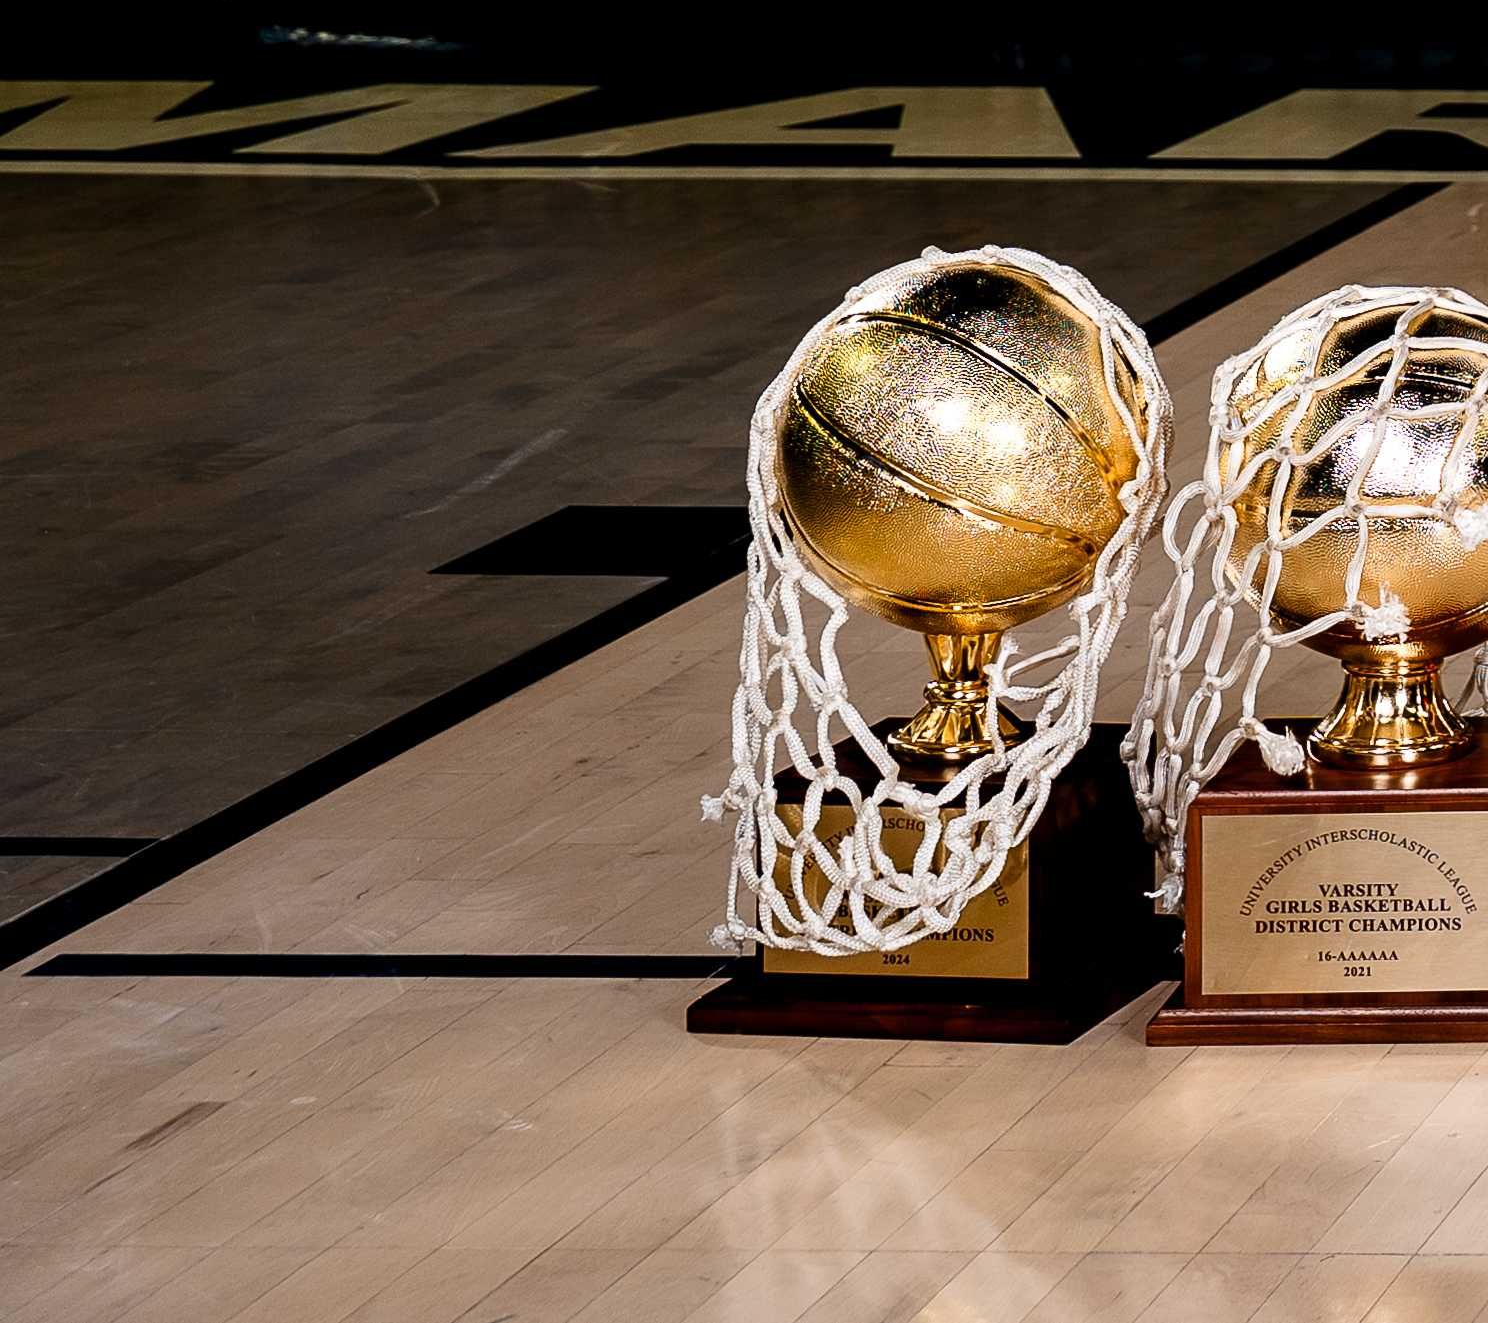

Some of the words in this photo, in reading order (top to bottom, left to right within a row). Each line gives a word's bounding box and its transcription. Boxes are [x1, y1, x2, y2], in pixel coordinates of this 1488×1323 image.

[1240, 844, 1304, 917] UNIVERSITY
[1306, 828, 1439, 865] INTERSCHOLASTIC
[1437, 860, 1478, 914] LEAGUE
[1318, 883, 1400, 897] VARSITY
[1266, 900, 1323, 914] GIRLS
[1328, 898, 1452, 913] BASKETBALL
[1255, 919, 1344, 934] DISTRICT
[1348, 917, 1462, 932] CHAMPIONS
[921, 928, 994, 942] MPIONS
[883, 953, 910, 965] 2024
[1318, 950, 1399, 962] 16-AAAAAA
[1344, 966, 1372, 977] 2021
